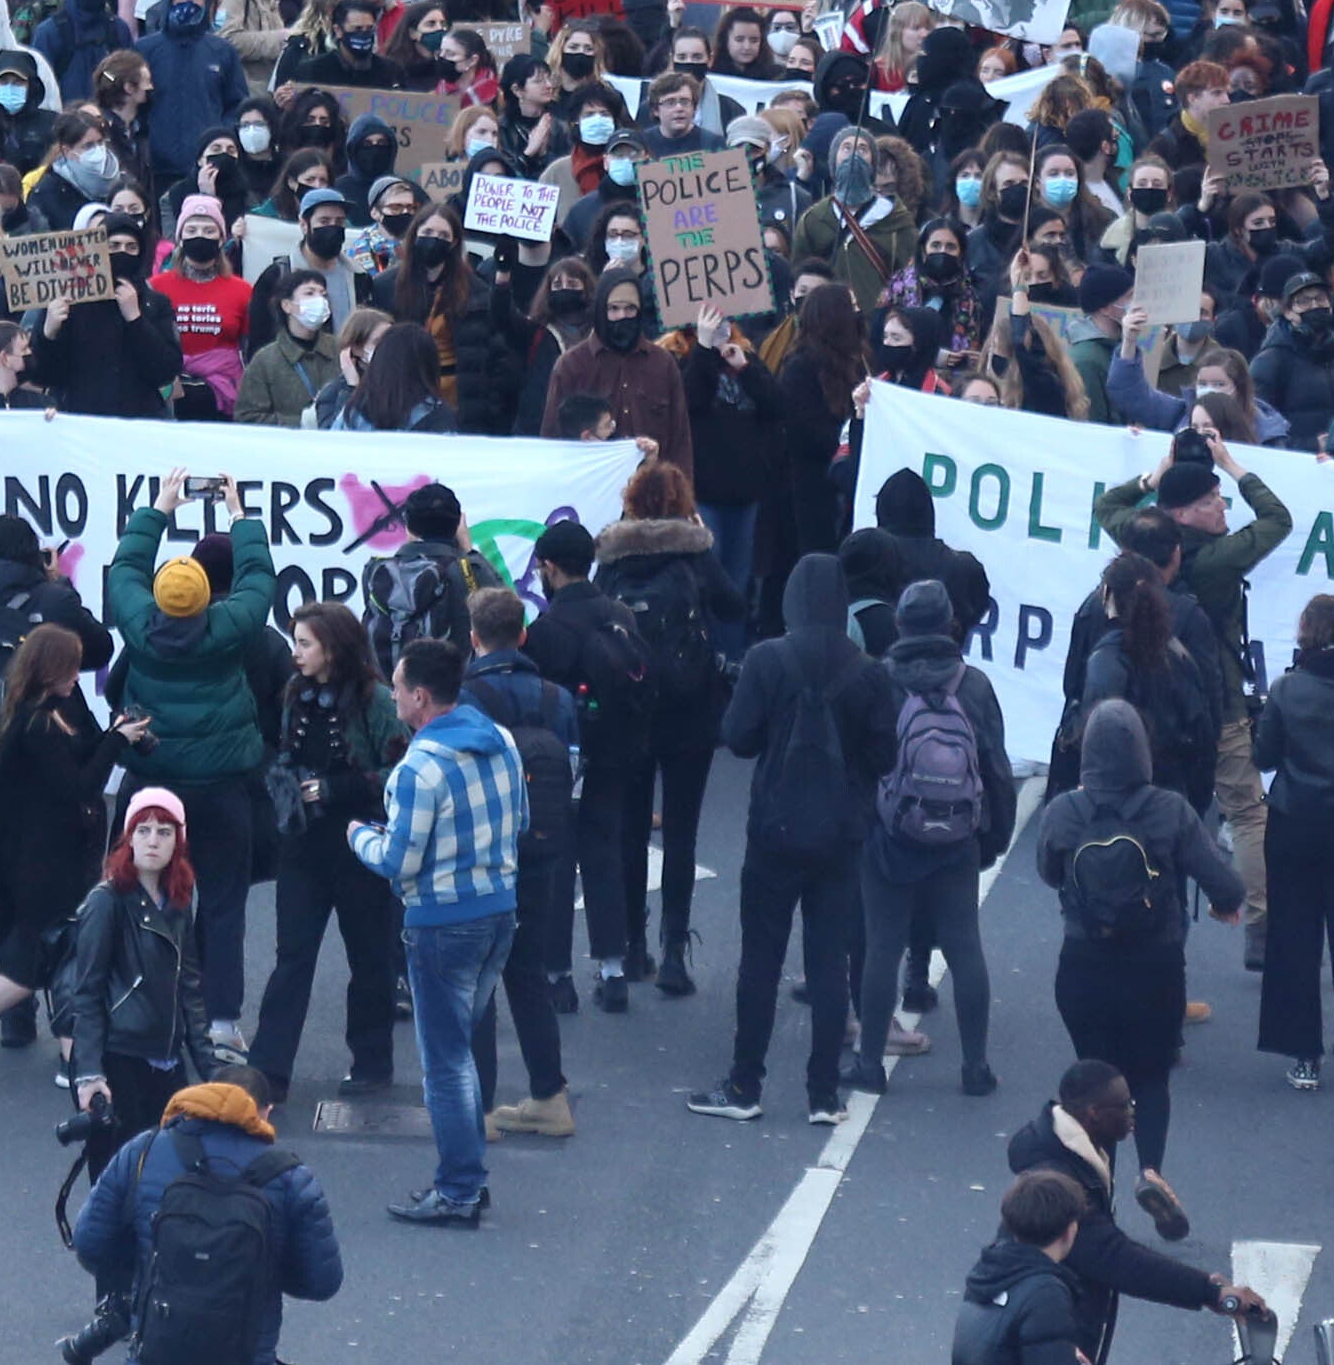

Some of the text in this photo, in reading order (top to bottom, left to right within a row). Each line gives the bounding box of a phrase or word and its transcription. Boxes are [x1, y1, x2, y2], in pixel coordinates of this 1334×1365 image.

[370, 93, 454, 125] POLICE
[1217, 109, 1311, 141] CRIME
[661, 153, 705, 175] THE
[1225, 142, 1315, 167] STARTS
[476, 177, 558, 202] POWER TO THE
[641, 167, 748, 211] POLICE
[473, 193, 551, 222] PEOPLE NOT
[474, 212, 498, 227] THE
[673, 203, 719, 230] ARE
[2, 228, 108, 258] WOMEN UNITED
[674, 227, 716, 248] THE
[13, 254, 101, 278] WILL NEVER
[659, 247, 765, 308] PERPS
[9, 274, 108, 307] BE DIVIDED
[176, 314, 222, 323] no tories
[177, 305, 191, 313] no
[190, 324, 222, 336] trump
[4, 471, 89, 538] NO
